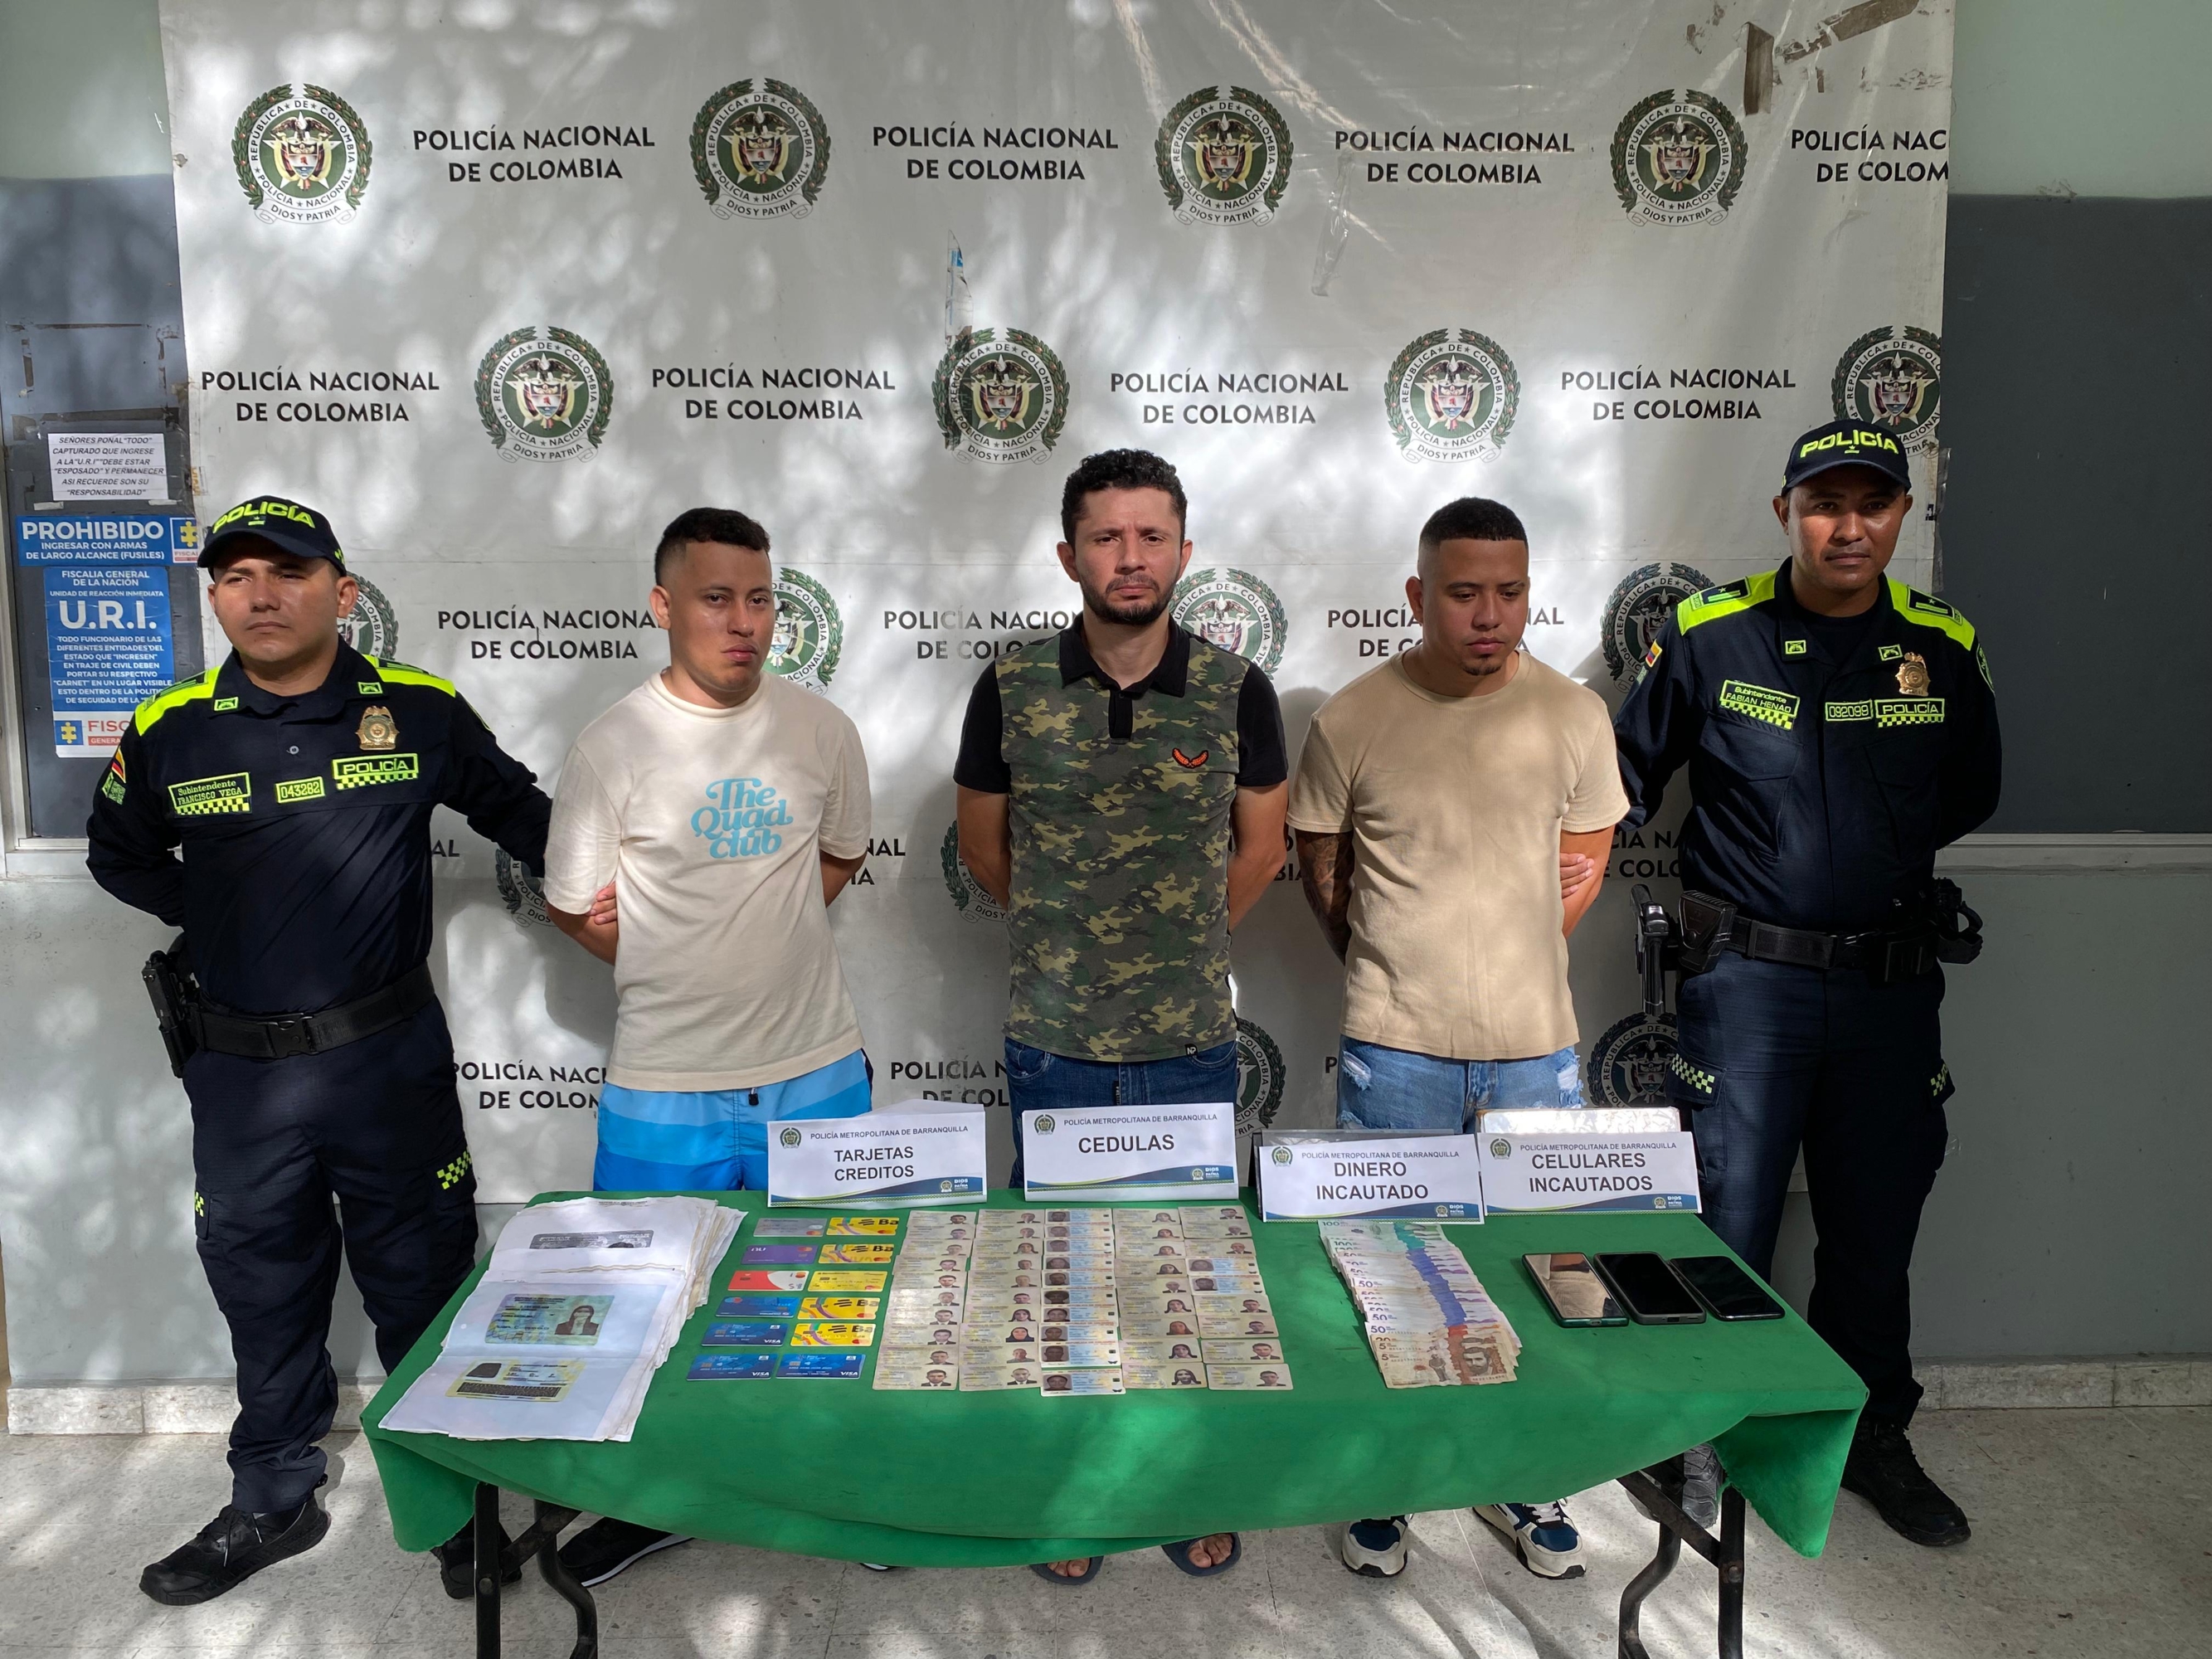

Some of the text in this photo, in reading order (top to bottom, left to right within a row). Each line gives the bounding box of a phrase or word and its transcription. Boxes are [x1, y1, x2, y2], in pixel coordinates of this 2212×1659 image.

[294, 100, 309, 109] DE
[319, 107, 356, 163] COLOMBIA
[413, 124, 655, 151] POLICÍA NACIONAL
[873, 120, 1119, 149] POLICÍA NACIONAL
[1335, 124, 1575, 153] POLICÍA NACIONAL
[1791, 123, 1885, 152] POLICÍA
[449, 158, 623, 182] DE COLOMBIA
[907, 158, 1086, 181] DE COLOMBIA
[1367, 163, 1542, 184] DE COLOMBIA
[1816, 161, 1949, 182] DE COLOM
[306, 175, 352, 207] NACIONAL
[306, 205, 341, 221] PATRIA
[202, 364, 440, 392] POLICÍA NACIONAL
[652, 361, 895, 390] POLICÍA NACIONAL
[1111, 367, 1349, 394] POLICÍA NACIONAL
[1562, 364, 1796, 391] POLICÍA NACIONAL
[236, 402, 410, 422] DE COLOMBIA
[685, 399, 863, 421] DE COLOMBIA
[1143, 404, 1316, 425] DE COLOMBIA
[1593, 399, 1762, 421] DE COLOMBIA
[1800, 429, 1898, 458] POLICÍA
[211, 501, 316, 534] POLICÍA
[22, 521, 164, 540] PROHIBIDO
[41, 542, 89, 550] INGRESAR
[91, 542, 111, 550] CON
[120, 551, 165, 561] (FUSILES)
[61, 570, 149, 578] FISCALIA GENERAL
[101, 577, 139, 586] NACIÓN
[59, 600, 157, 630] U.R.I.
[437, 605, 662, 630] POLICÍA NACIONA
[884, 605, 1079, 630] POLICÍA NACIO
[471, 640, 638, 659] DE COLOMBIA
[917, 640, 948, 659] DE
[1359, 639, 1389, 657] DE
[1725, 693, 1757, 706] FABIAN
[1883, 701, 1939, 714] POLICÍA
[1829, 704, 1869, 718] 092099
[343, 758, 409, 775] POLICÍA
[177, 779, 236, 796] Subintendente
[177, 786, 242, 806] FRANCISCO VEGA
[280, 781, 321, 800] 043282
[706, 777, 776, 810] The
[691, 799, 794, 840] Quad
[709, 828, 782, 859] club
[891, 1054, 987, 1080] POLICÍA
[479, 1091, 510, 1109] DE
[1063, 1117, 1091, 1126] POLICÍA
[1092, 1115, 1151, 1125] METROPOLITANA
[1164, 1114, 1218, 1122] BARRANQUILLA
[810, 1131, 839, 1140] POLICÍA
[840, 1129, 900, 1139] METROPOLITANA
[912, 1126, 969, 1136] BARRANQUILLA
[834, 1146, 914, 1162] TARJETAS
[1078, 1134, 1174, 1154] CEDULAS
[1520, 1143, 1548, 1151] POLICÍA
[1301, 1151, 1330, 1159] POLICÍA
[1531, 1152, 1646, 1170] CELULARES
[834, 1165, 915, 1181] CREDITOS
[1334, 1161, 1407, 1177] DINERO
[1317, 1185, 1429, 1199] INCAUTADO
[1529, 1175, 1653, 1193] INCAUTADOS
